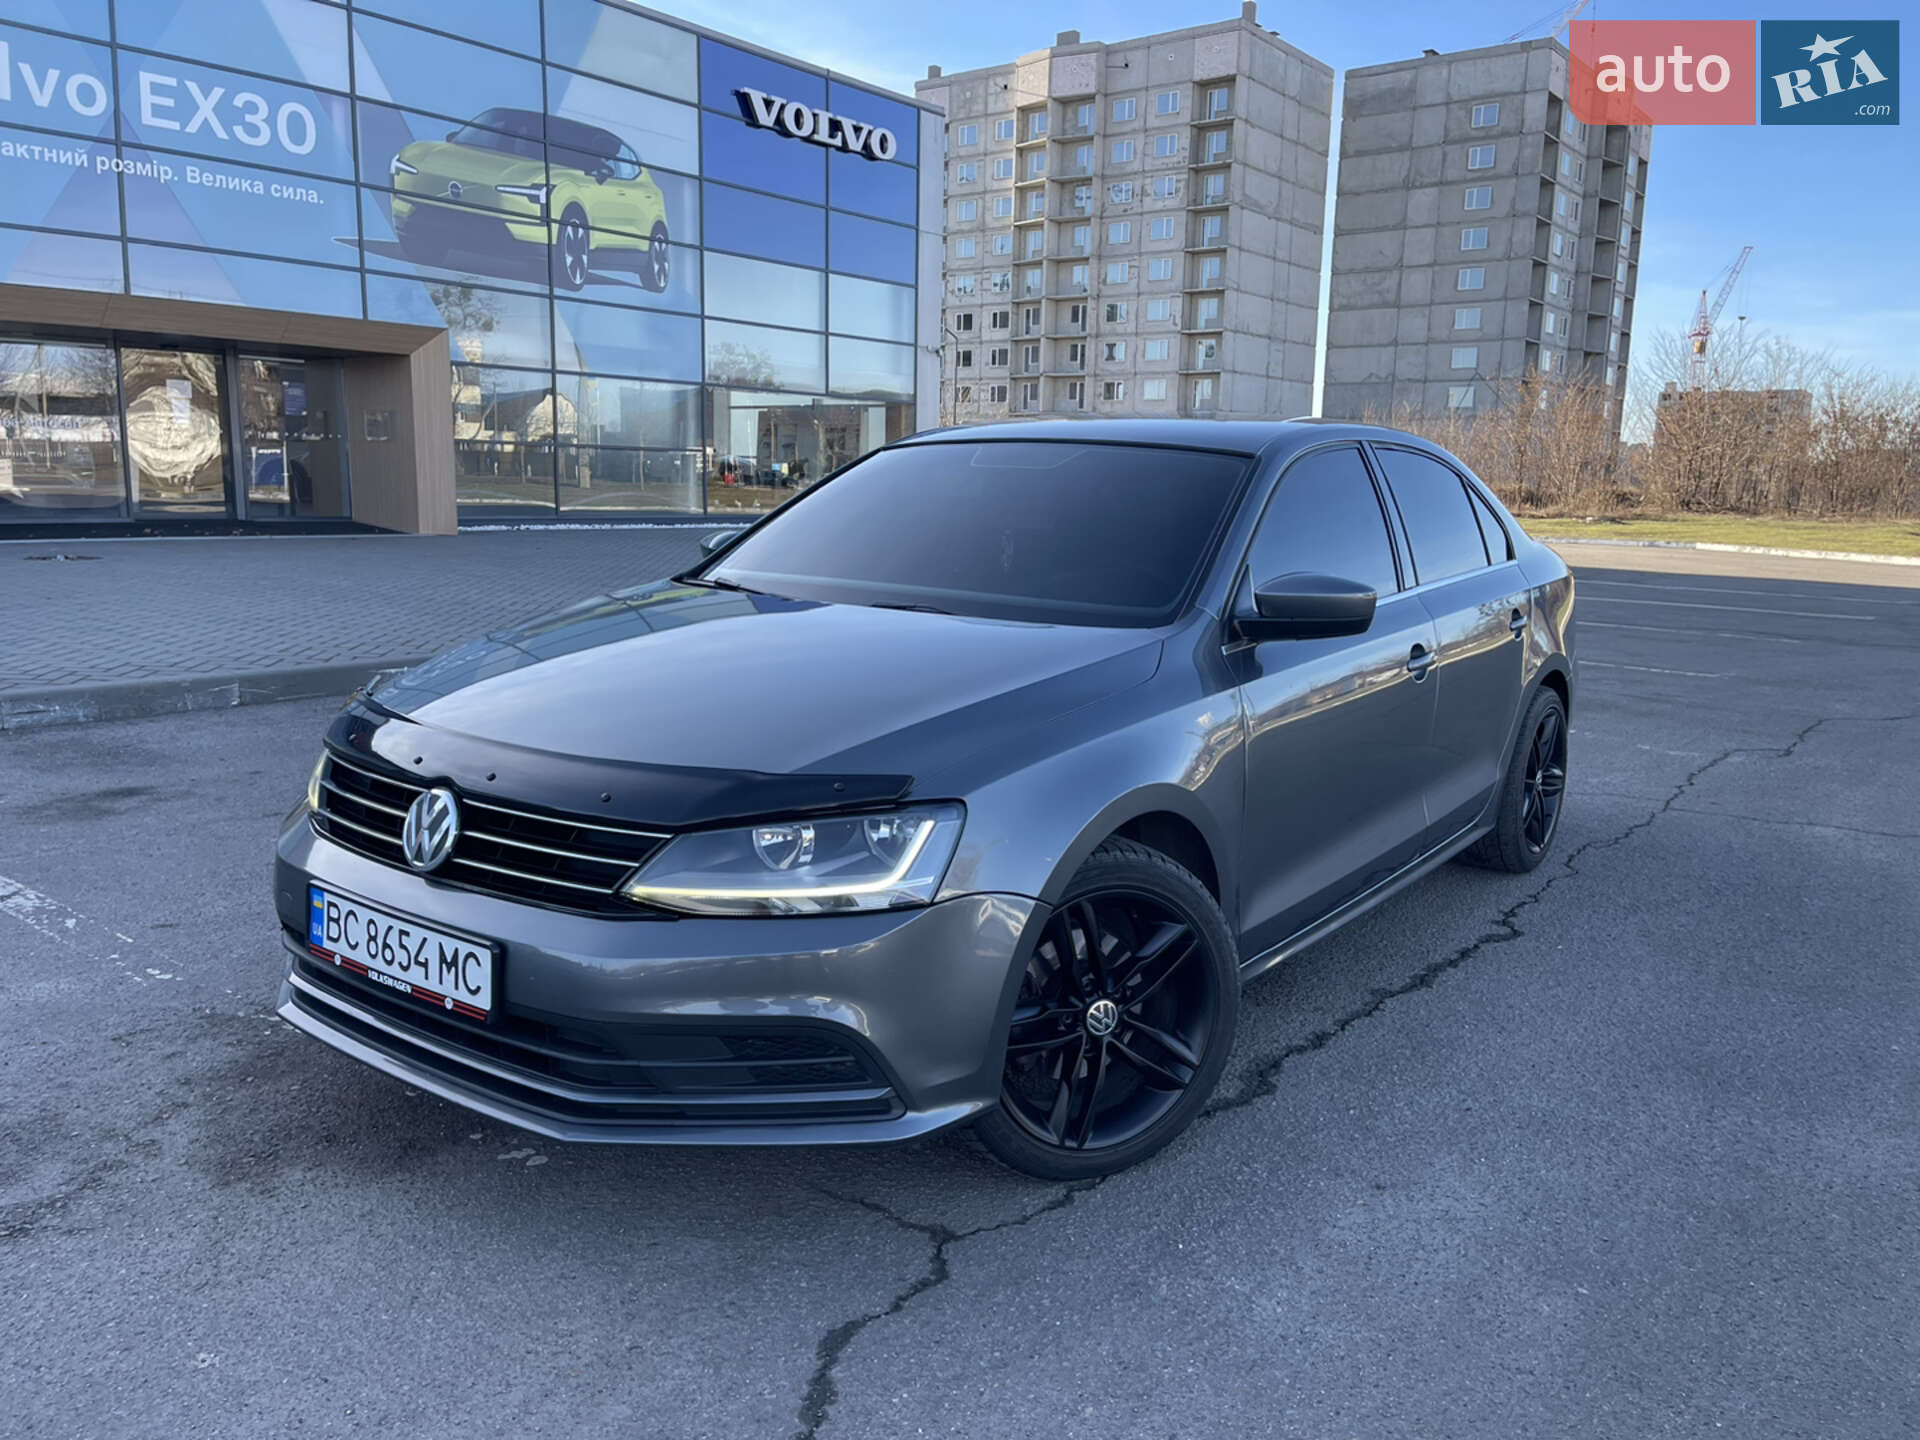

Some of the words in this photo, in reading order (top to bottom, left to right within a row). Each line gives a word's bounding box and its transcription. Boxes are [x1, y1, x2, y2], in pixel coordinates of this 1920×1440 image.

[138, 70, 317, 155] EX30
[740, 87, 897, 160] VOLVO
[96, 155, 179, 184] розмір.
[186, 166, 265, 195] Велика
[271, 183, 325, 205] сила.
[327, 900, 359, 950] BC
[366, 918, 429, 981] 8654
[439, 941, 482, 996] MC
